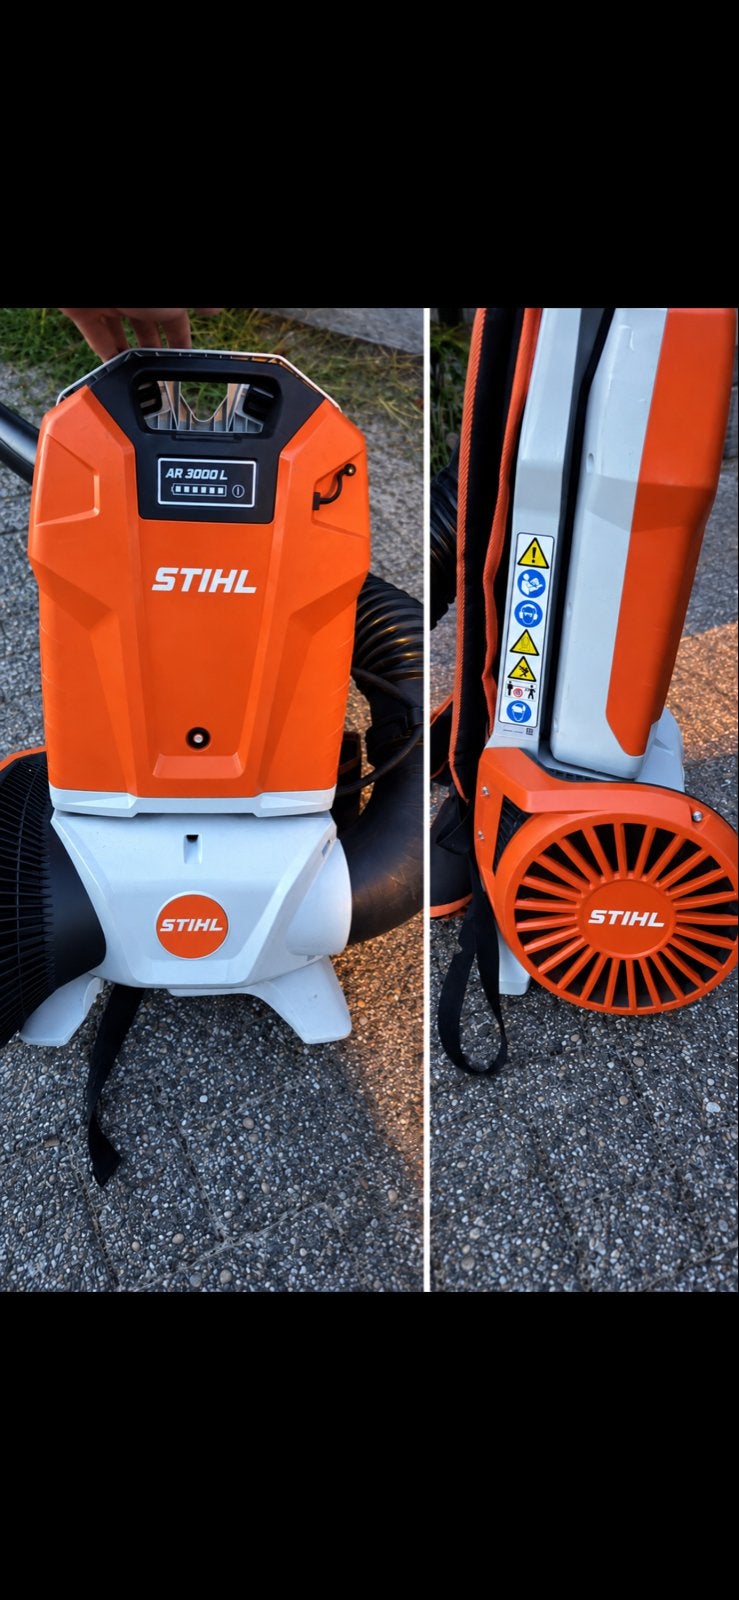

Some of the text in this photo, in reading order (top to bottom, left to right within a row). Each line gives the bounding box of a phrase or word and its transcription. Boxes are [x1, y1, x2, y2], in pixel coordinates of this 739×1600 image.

[165, 468, 228, 480] AR 3000 L
[151, 567, 257, 593] STIHL
[159, 918, 224, 932] STIHL
[587, 909, 665, 928] STIHL
